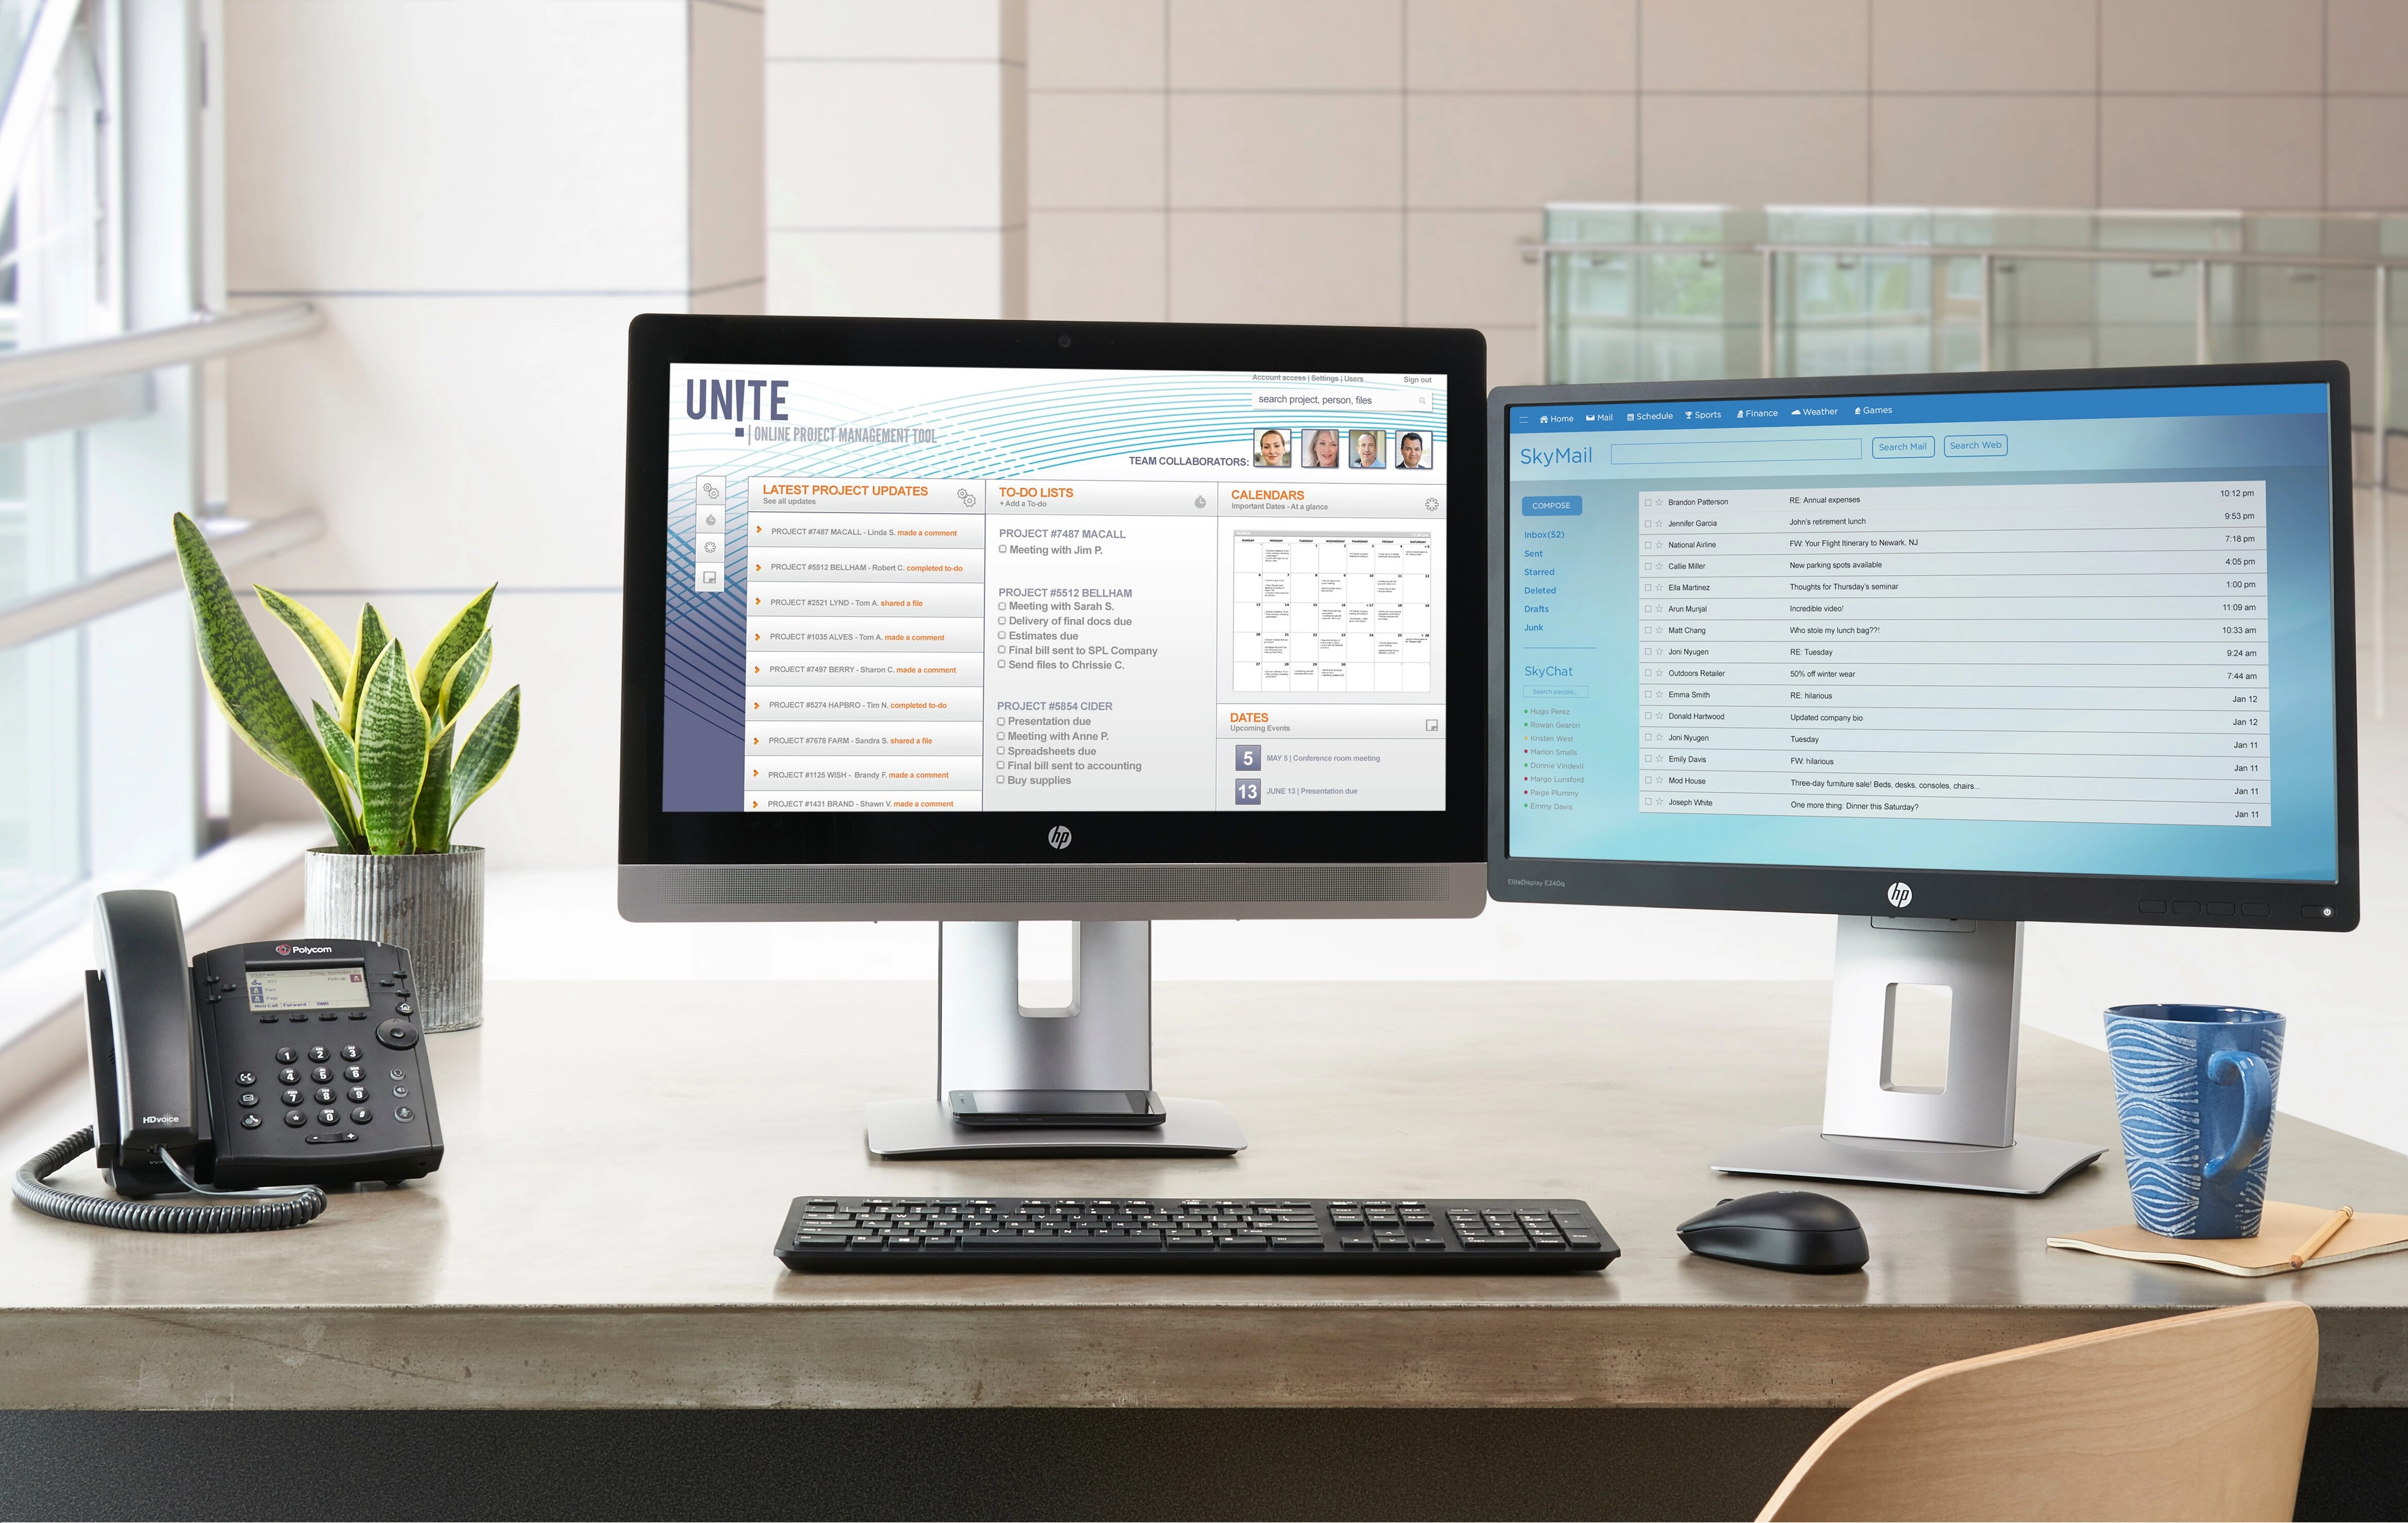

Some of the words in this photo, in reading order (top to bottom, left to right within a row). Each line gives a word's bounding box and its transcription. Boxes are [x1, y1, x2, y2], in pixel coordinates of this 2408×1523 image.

[1311, 374, 1339, 383] Settings
[1259, 395, 1287, 403] search
[1289, 395, 1320, 406] project,
[1322, 397, 1353, 406] person,
[1355, 395, 1373, 405] files
[1802, 407, 1839, 416] Weather
[1862, 406, 1893, 415] Games
[1597, 413, 1613, 422] Mail
[1636, 411, 1674, 420] Schedule
[1694, 411, 1722, 420] Sports
[754, 426, 791, 442] ONLINE
[793, 427, 837, 442] PROJECT
[838, 427, 911, 443] MANAGEMENT
[912, 428, 937, 443] TOOL
[1879, 443, 1908, 451] Search
[1910, 442, 1927, 450] Mail
[1950, 441, 1980, 450] Search
[1981, 440, 2002, 449] Web
[1521, 446, 1592, 467] SkyMail
[1129, 456, 1157, 465] TEAM
[1159, 457, 1249, 467] COLLABORATORS:
[763, 484, 810, 495] LATEST
[812, 485, 870, 496] PROJECT
[872, 486, 929, 496] UPDATES
[999, 487, 1038, 497] TO-DO
[1040, 487, 1074, 498] LISTS
[2221, 489, 2241, 497] 10:12
[1231, 489, 1305, 501] CALENDARS
[788, 497, 816, 506] updates
[1524, 531, 1565, 539] Inbox(52)
[1822, 539, 1840, 548] Flight
[1842, 539, 1869, 548] Itinerary
[1010, 544, 1048, 556] Meeting
[1050, 545, 1072, 555] with
[1074, 545, 1092, 555] Jim
[1094, 546, 1103, 555] P.
[1524, 549, 1543, 558] Sent
[1524, 568, 1555, 576] Starred
[1524, 586, 1556, 595] Deleted
[1524, 605, 1550, 613] Drafts
[1009, 616, 1049, 628] Delivery
[1051, 616, 1062, 625] of
[1063, 616, 1085, 625] final
[1087, 617, 1111, 626] docs
[1113, 617, 1133, 626] due
[1524, 666, 1573, 678] SkyChat
[997, 701, 1047, 711] PROJECT
[1048, 701, 1079, 711] #5854
[1080, 701, 1113, 711] CIDER
[1230, 712, 1269, 723] DATES
[1230, 724, 1265, 733] Upcoming
[1242, 750, 1254, 767] 5
[1353, 755, 1381, 763] meeting
[1008, 775, 1027, 787] Buy
[1030, 775, 1072, 787] supplies
[1238, 783, 1258, 800] 13
[1530, 802, 1552, 811] Emmy
[1669, 799, 1692, 807] Joseph
[1790, 800, 1805, 809] One
[1825, 802, 1844, 811] thing:
[1846, 802, 1869, 810] Dinner
[1884, 803, 1919, 812] Saturday?
[1049, 825, 1071, 849] hp
[1508, 878, 1543, 887] EliteDisplay
[1544, 879, 1566, 888] E240q
[1889, 882, 1911, 908] hp
[292, 946, 332, 955] Polycom
[284, 1052, 290, 1060] 1
[317, 1051, 324, 1059] 2
[349, 1049, 356, 1058] 3
[287, 1073, 295, 1081] 4
[319, 1071, 327, 1080] 5
[290, 1094, 297, 1102] 7
[142, 1116, 179, 1124] HDvoice
[326, 1113, 334, 1122] 0
